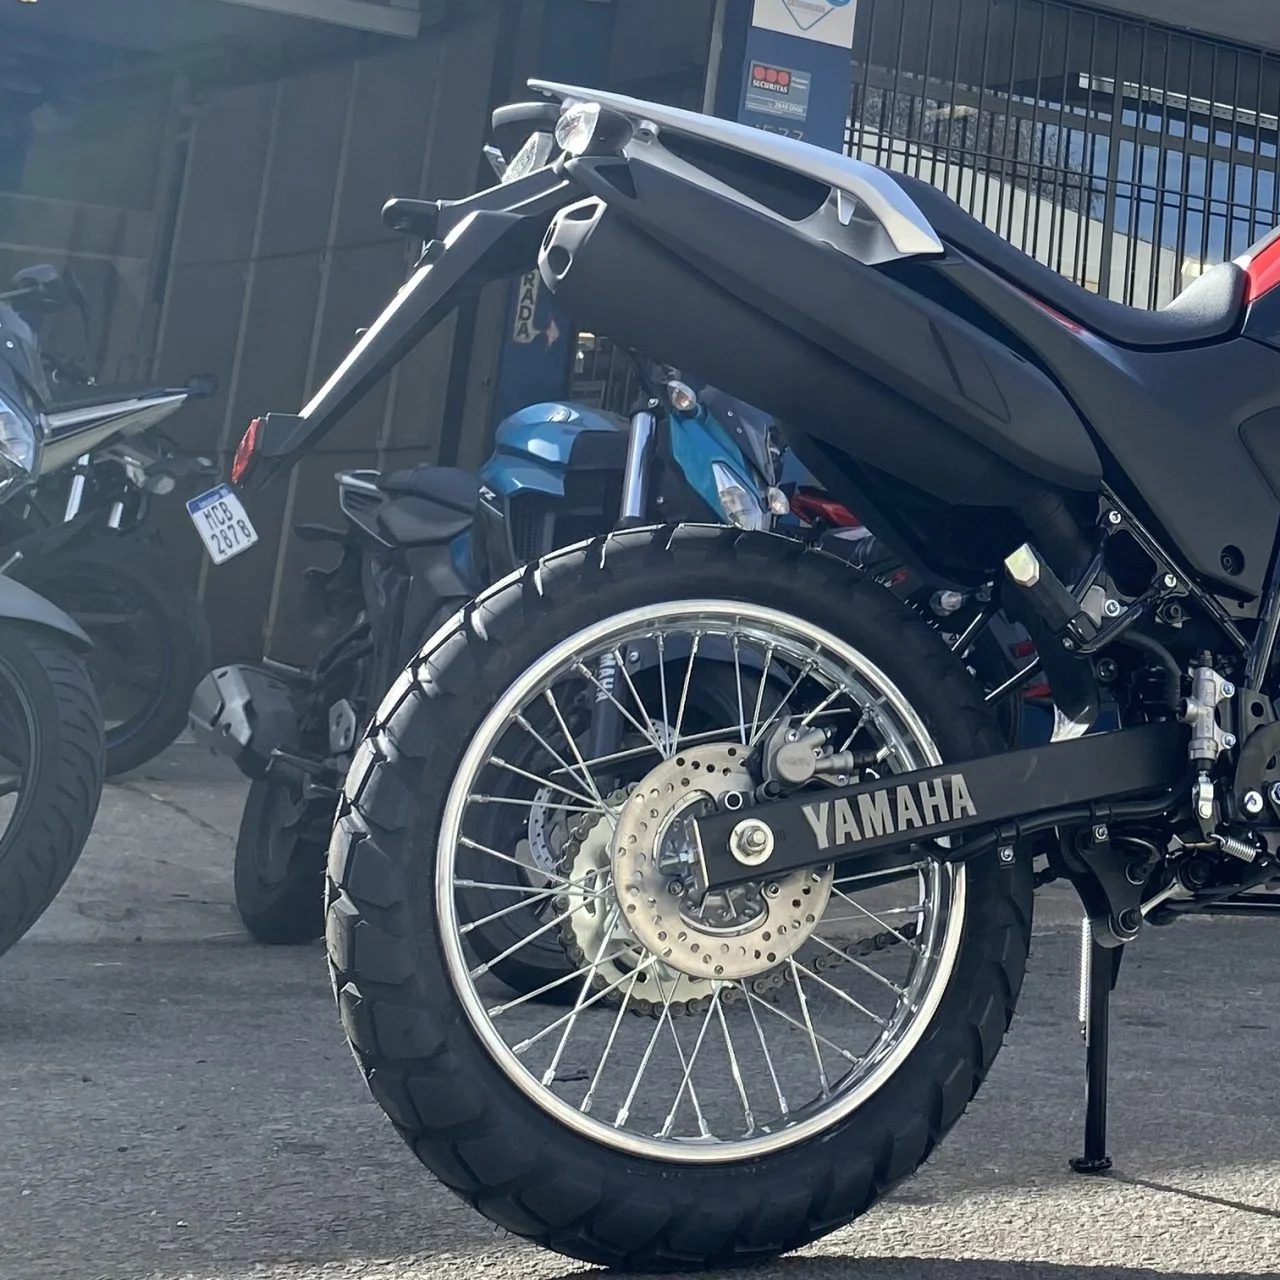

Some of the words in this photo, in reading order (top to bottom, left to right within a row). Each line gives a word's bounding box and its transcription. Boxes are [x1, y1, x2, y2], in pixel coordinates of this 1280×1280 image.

[752, 79, 788, 94] SECURITAS
[517, 271, 536, 340] RADA
[479, 485, 496, 501] FZ
[203, 501, 233, 531] MCB
[211, 519, 252, 555] 2878
[595, 651, 616, 704] MAHA
[801, 773, 977, 850] YAMAHA
